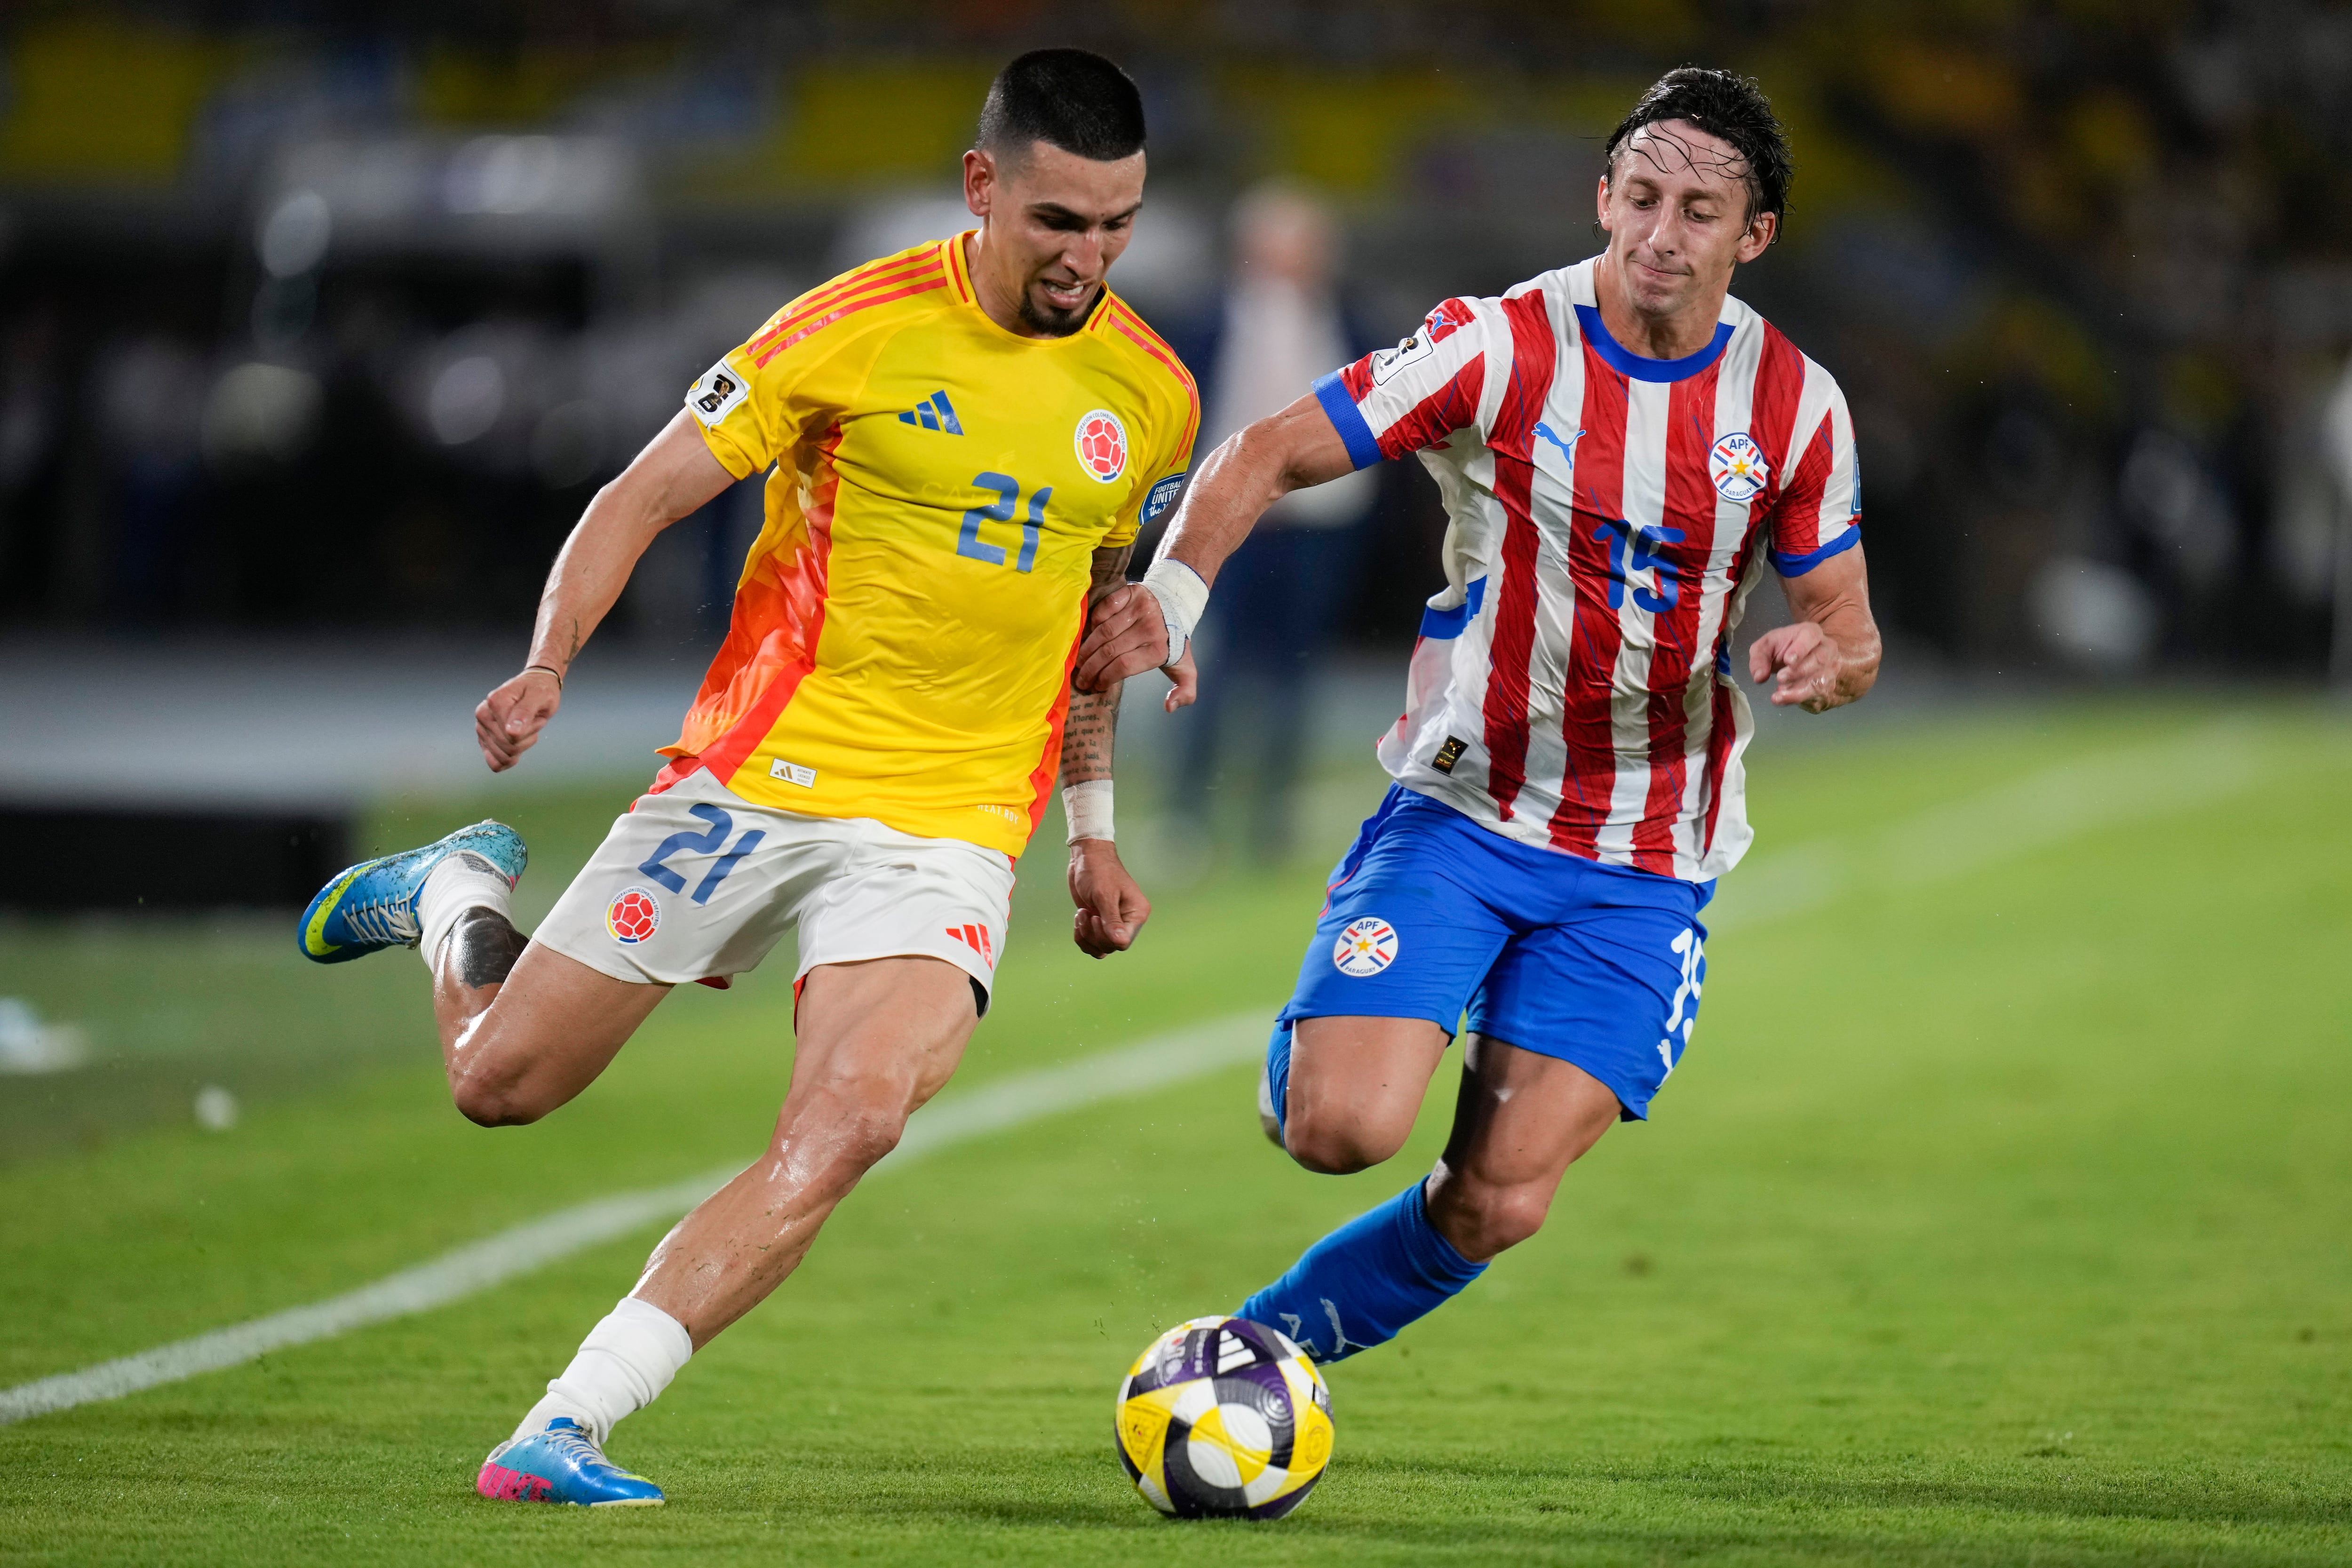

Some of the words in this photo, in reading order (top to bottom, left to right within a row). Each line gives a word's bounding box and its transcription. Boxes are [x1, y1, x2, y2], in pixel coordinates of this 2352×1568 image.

[1093, 412, 1117, 426] COLOMBIANA
[1729, 438, 1748, 449] APF
[1725, 486, 1752, 496] PARAGUAY
[1148, 505, 1162, 517] the
[956, 471, 1053, 573] 21
[1593, 519, 1686, 613] 15
[638, 803, 766, 906] 21
[635, 888, 656, 904] COLOMBIANA
[1356, 921, 1379, 930] APF
